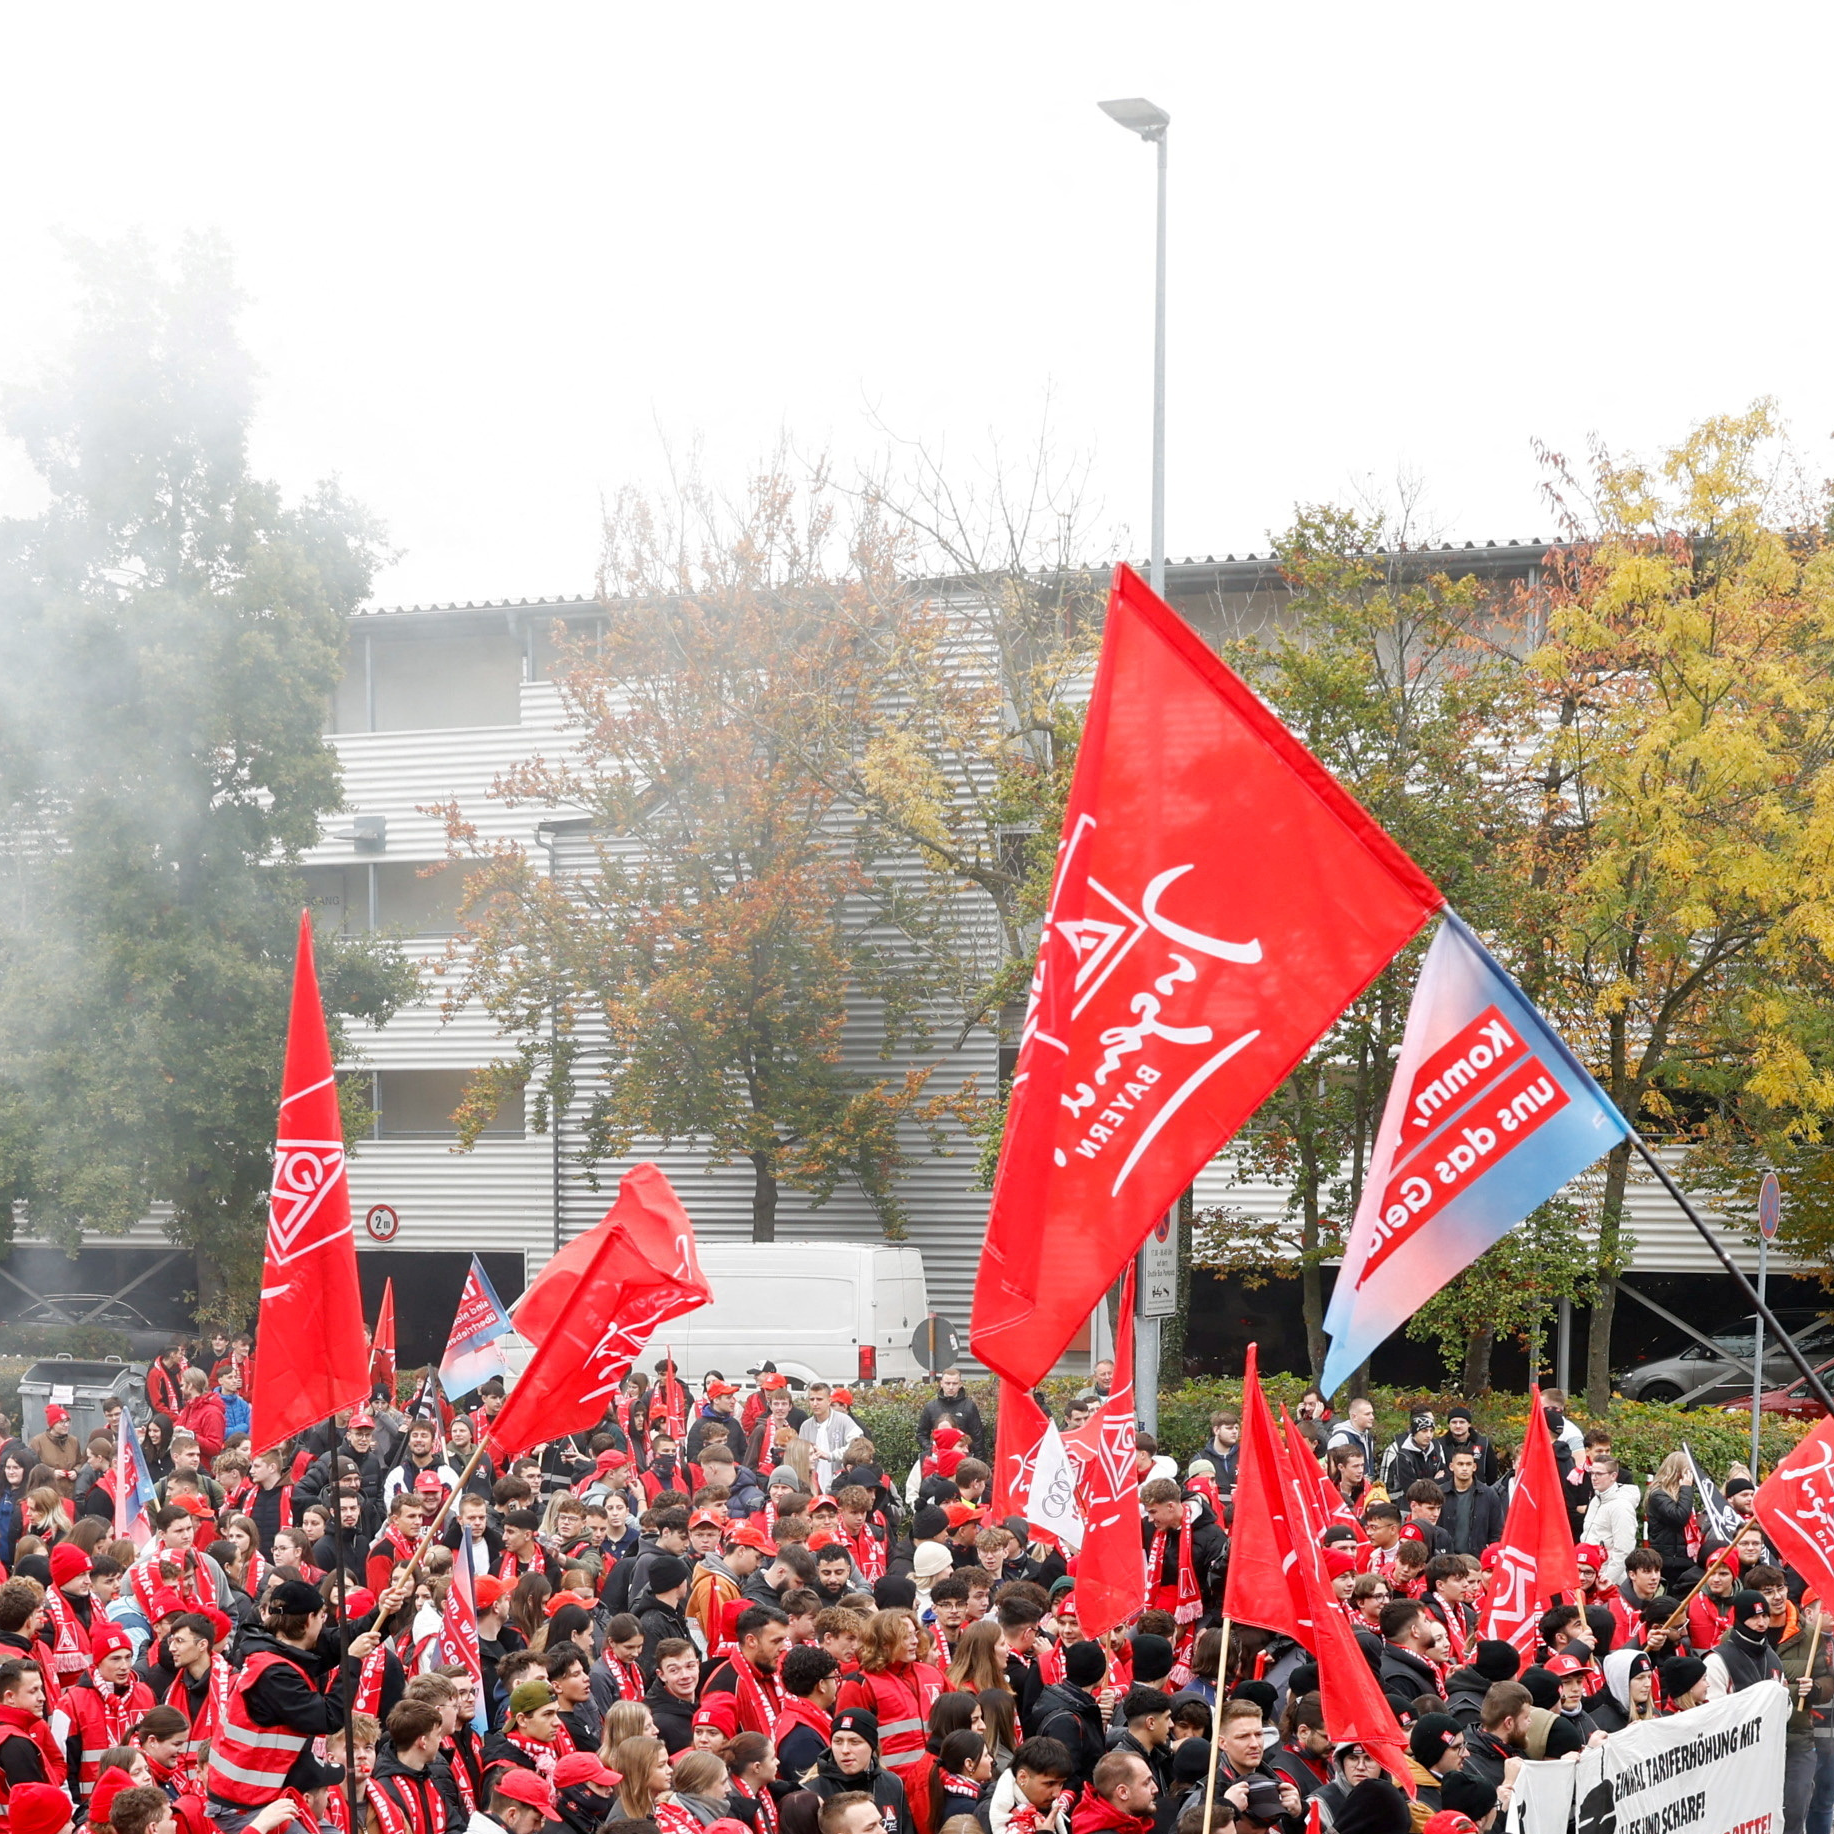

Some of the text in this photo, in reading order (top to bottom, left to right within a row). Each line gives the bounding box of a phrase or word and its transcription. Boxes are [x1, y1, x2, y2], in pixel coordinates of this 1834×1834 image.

[375, 1215, 382, 1230] 2
[1645, 1731, 1740, 1793] TARIFERHÖHUNG
[1740, 1716, 1764, 1749] MIT
